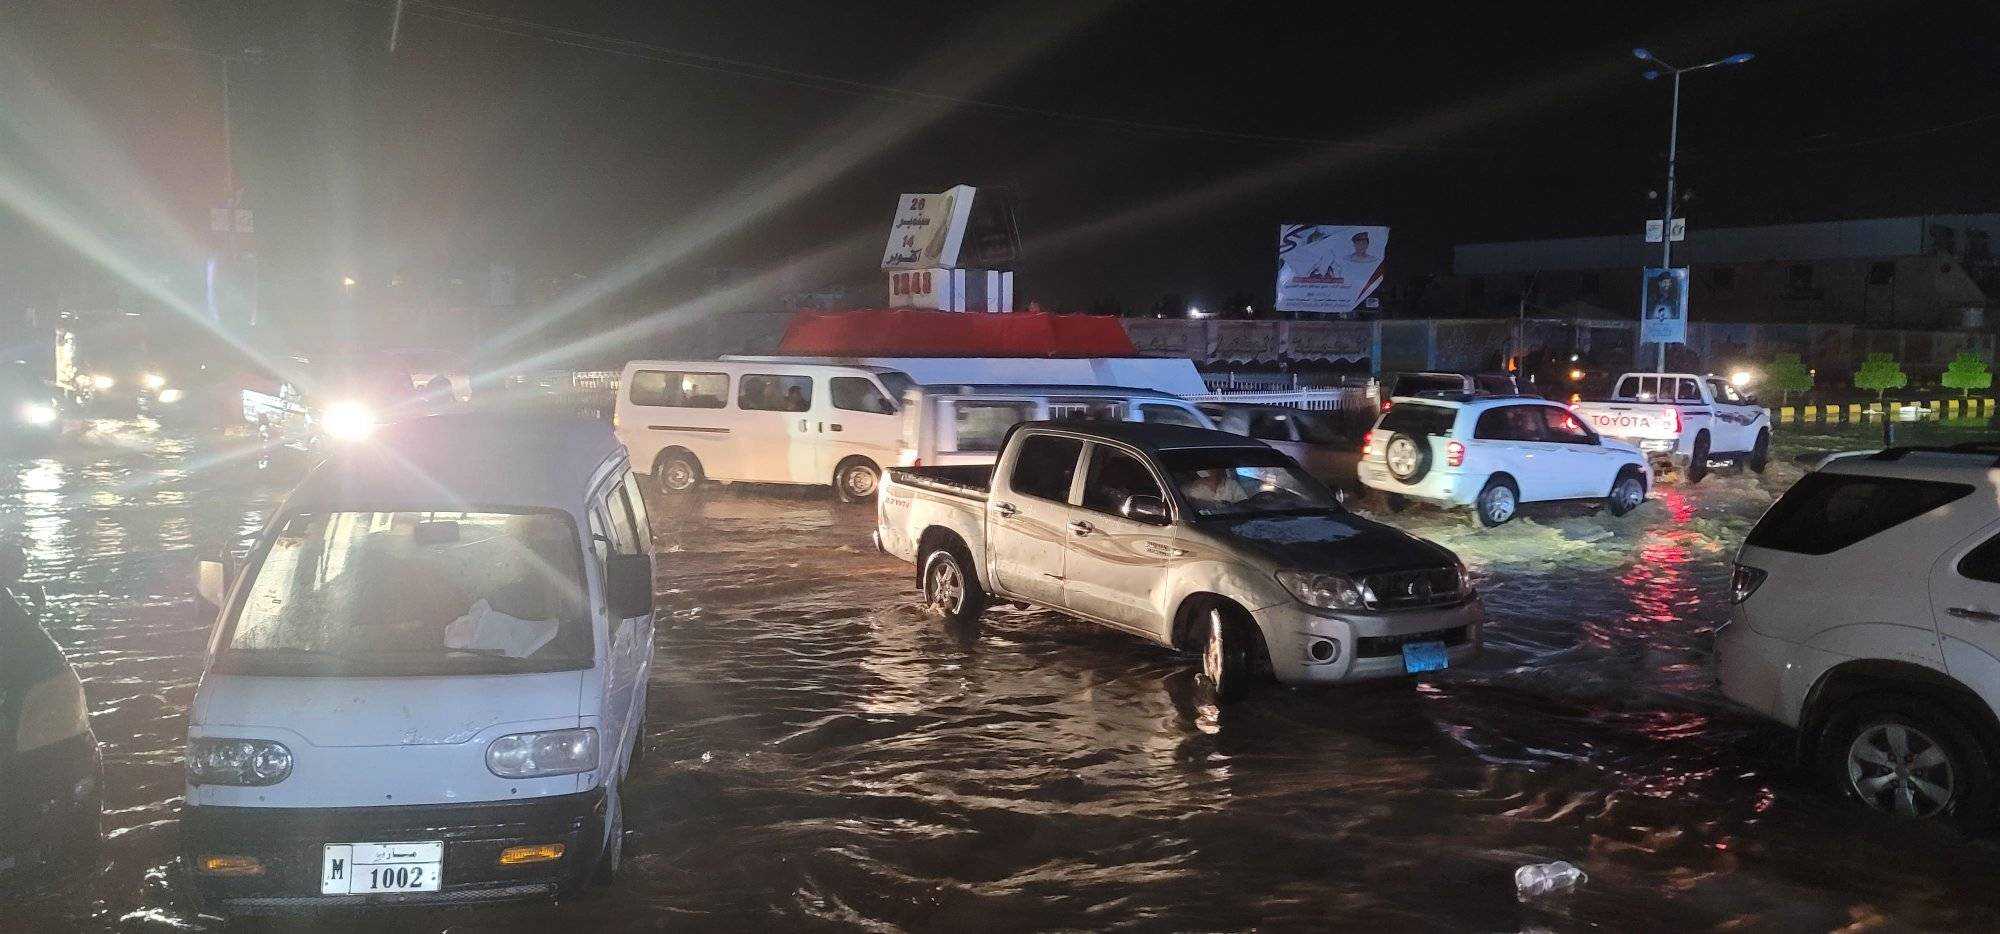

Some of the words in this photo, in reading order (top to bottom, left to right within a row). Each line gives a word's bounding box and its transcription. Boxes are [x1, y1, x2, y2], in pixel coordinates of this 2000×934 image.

[1591, 415, 1650, 428] TOYOTA
[331, 858, 344, 880] M
[369, 867, 424, 889] 1002
